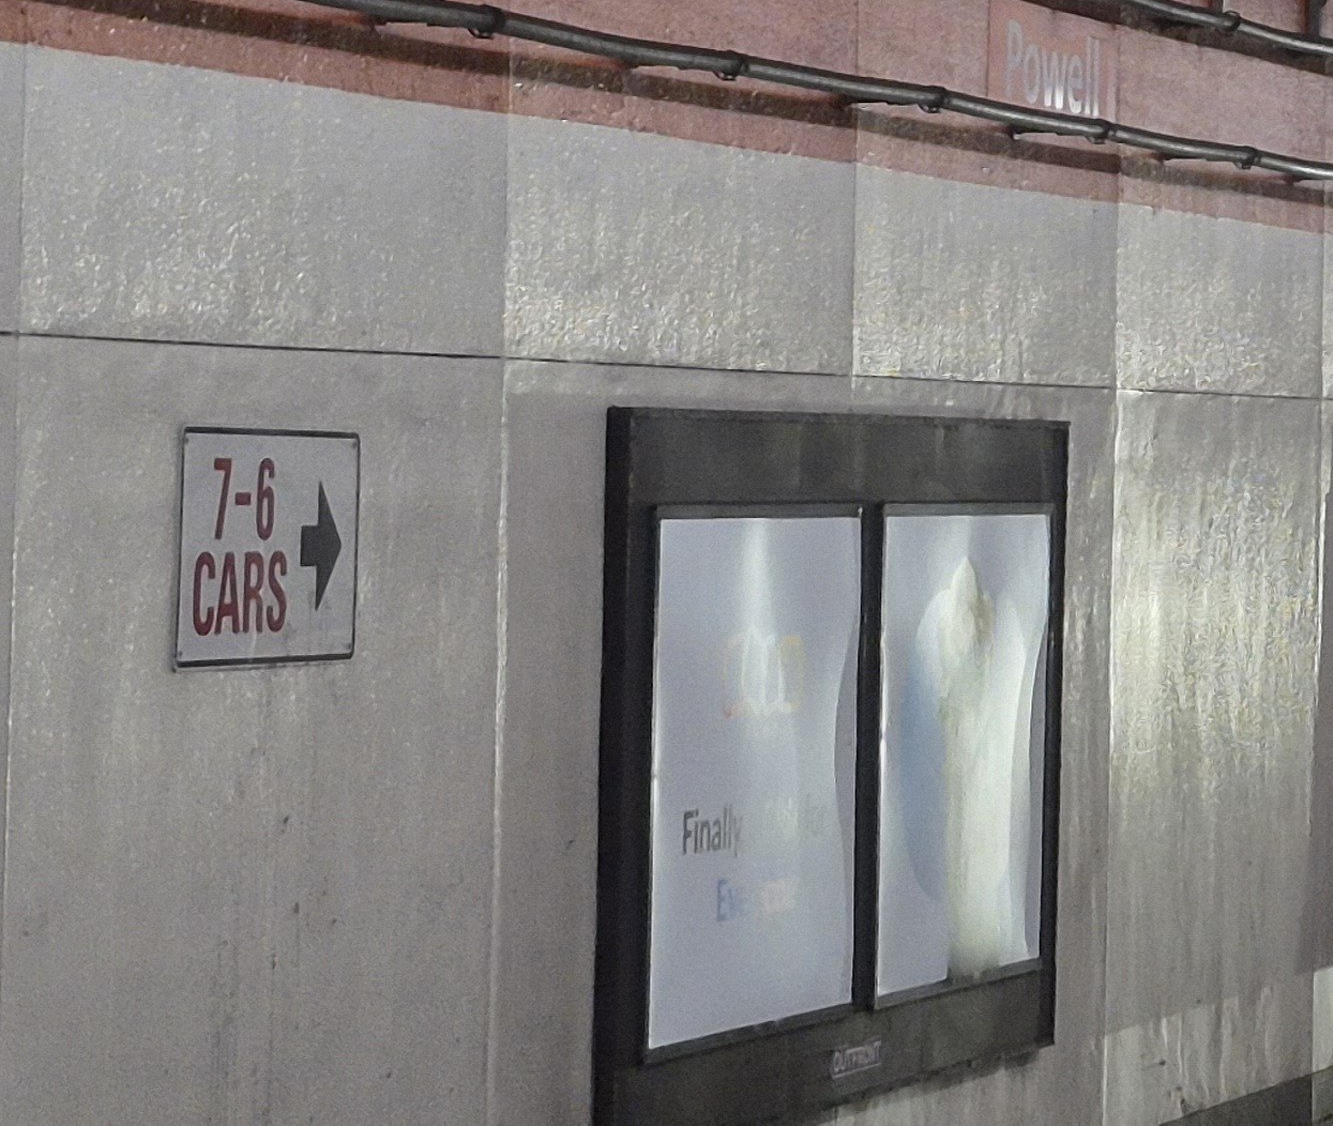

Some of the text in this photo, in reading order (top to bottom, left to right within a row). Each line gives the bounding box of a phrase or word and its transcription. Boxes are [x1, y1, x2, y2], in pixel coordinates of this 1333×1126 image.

[1005, 19, 1101, 117] Powell
[213, 457, 276, 542] 7-6
[192, 550, 288, 637] CARS
[681, 803, 744, 858] Finally
